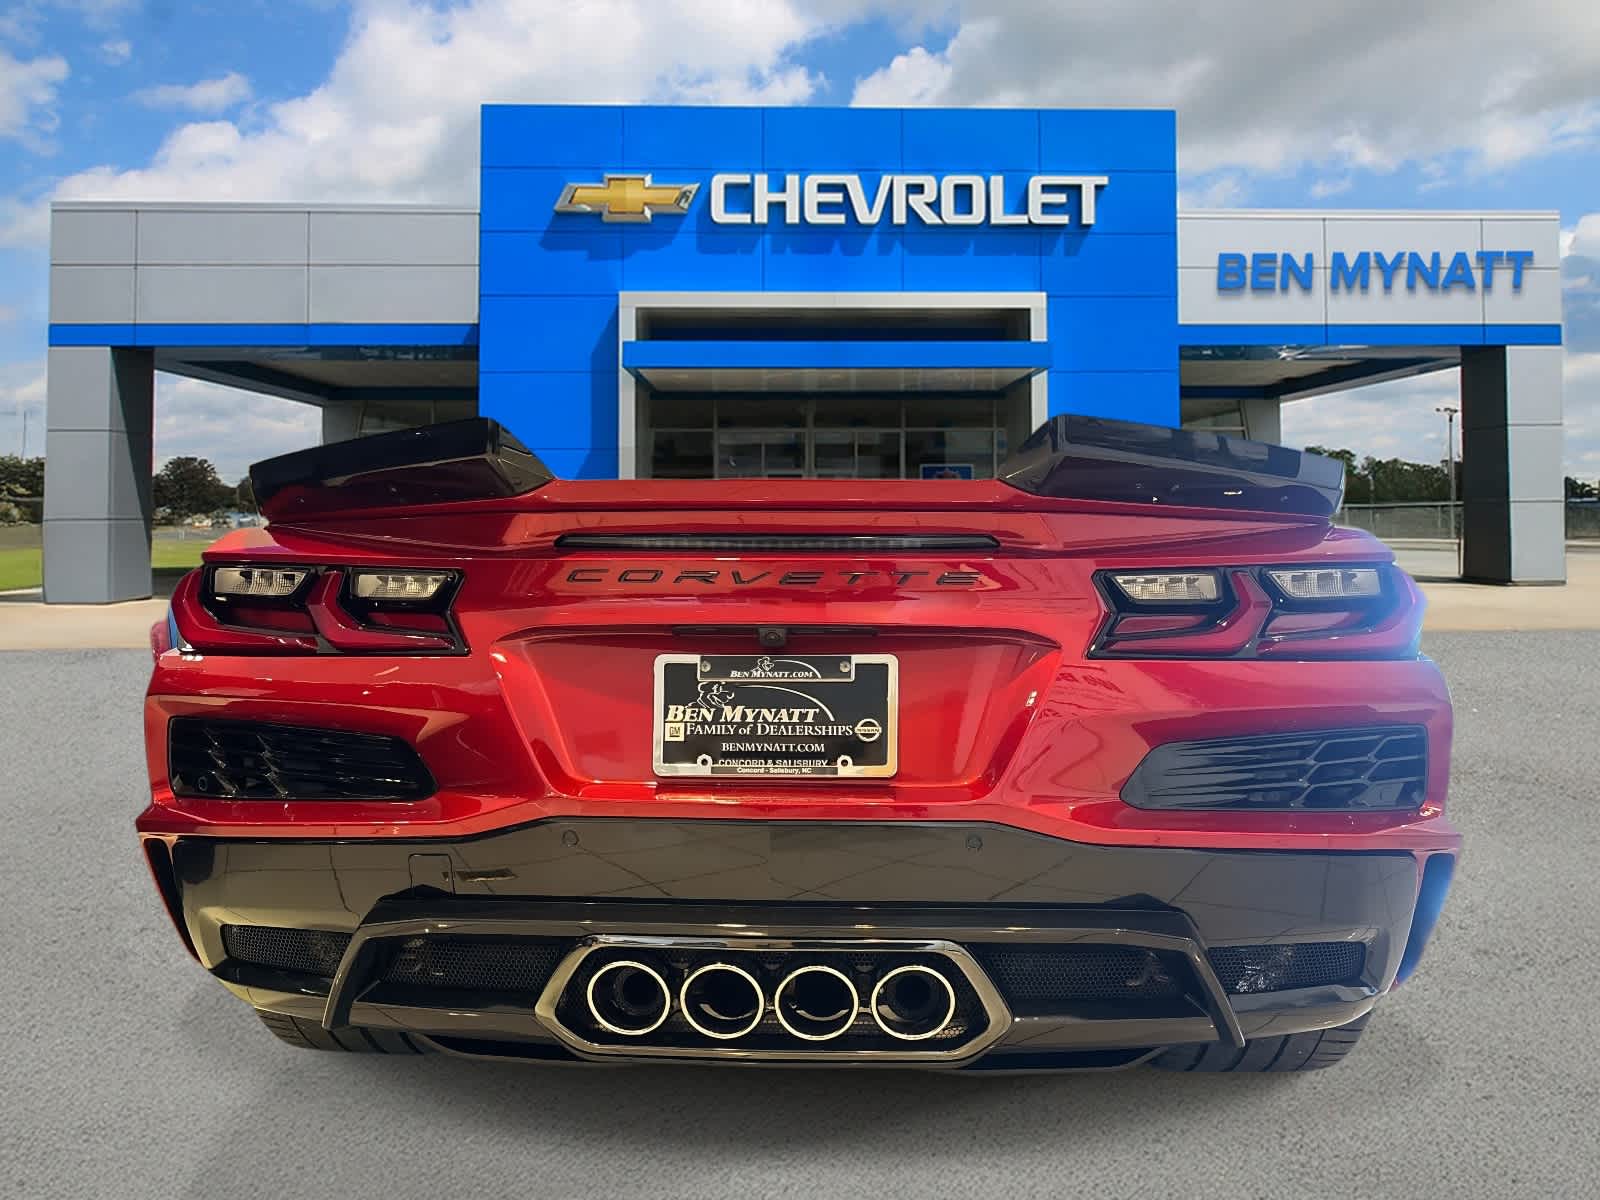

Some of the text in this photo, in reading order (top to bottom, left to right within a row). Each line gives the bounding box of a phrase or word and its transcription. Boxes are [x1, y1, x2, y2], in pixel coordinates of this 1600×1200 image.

[710, 173, 1109, 225] CHEVROLET
[1216, 251, 1534, 291] BEN MYNATT
[566, 568, 983, 586] CORVETTE
[665, 705, 820, 723] BEN MYNATT
[686, 723, 853, 736] FAMILY of DEALERSHIPS
[721, 742, 825, 752] BENMYNATT.COM
